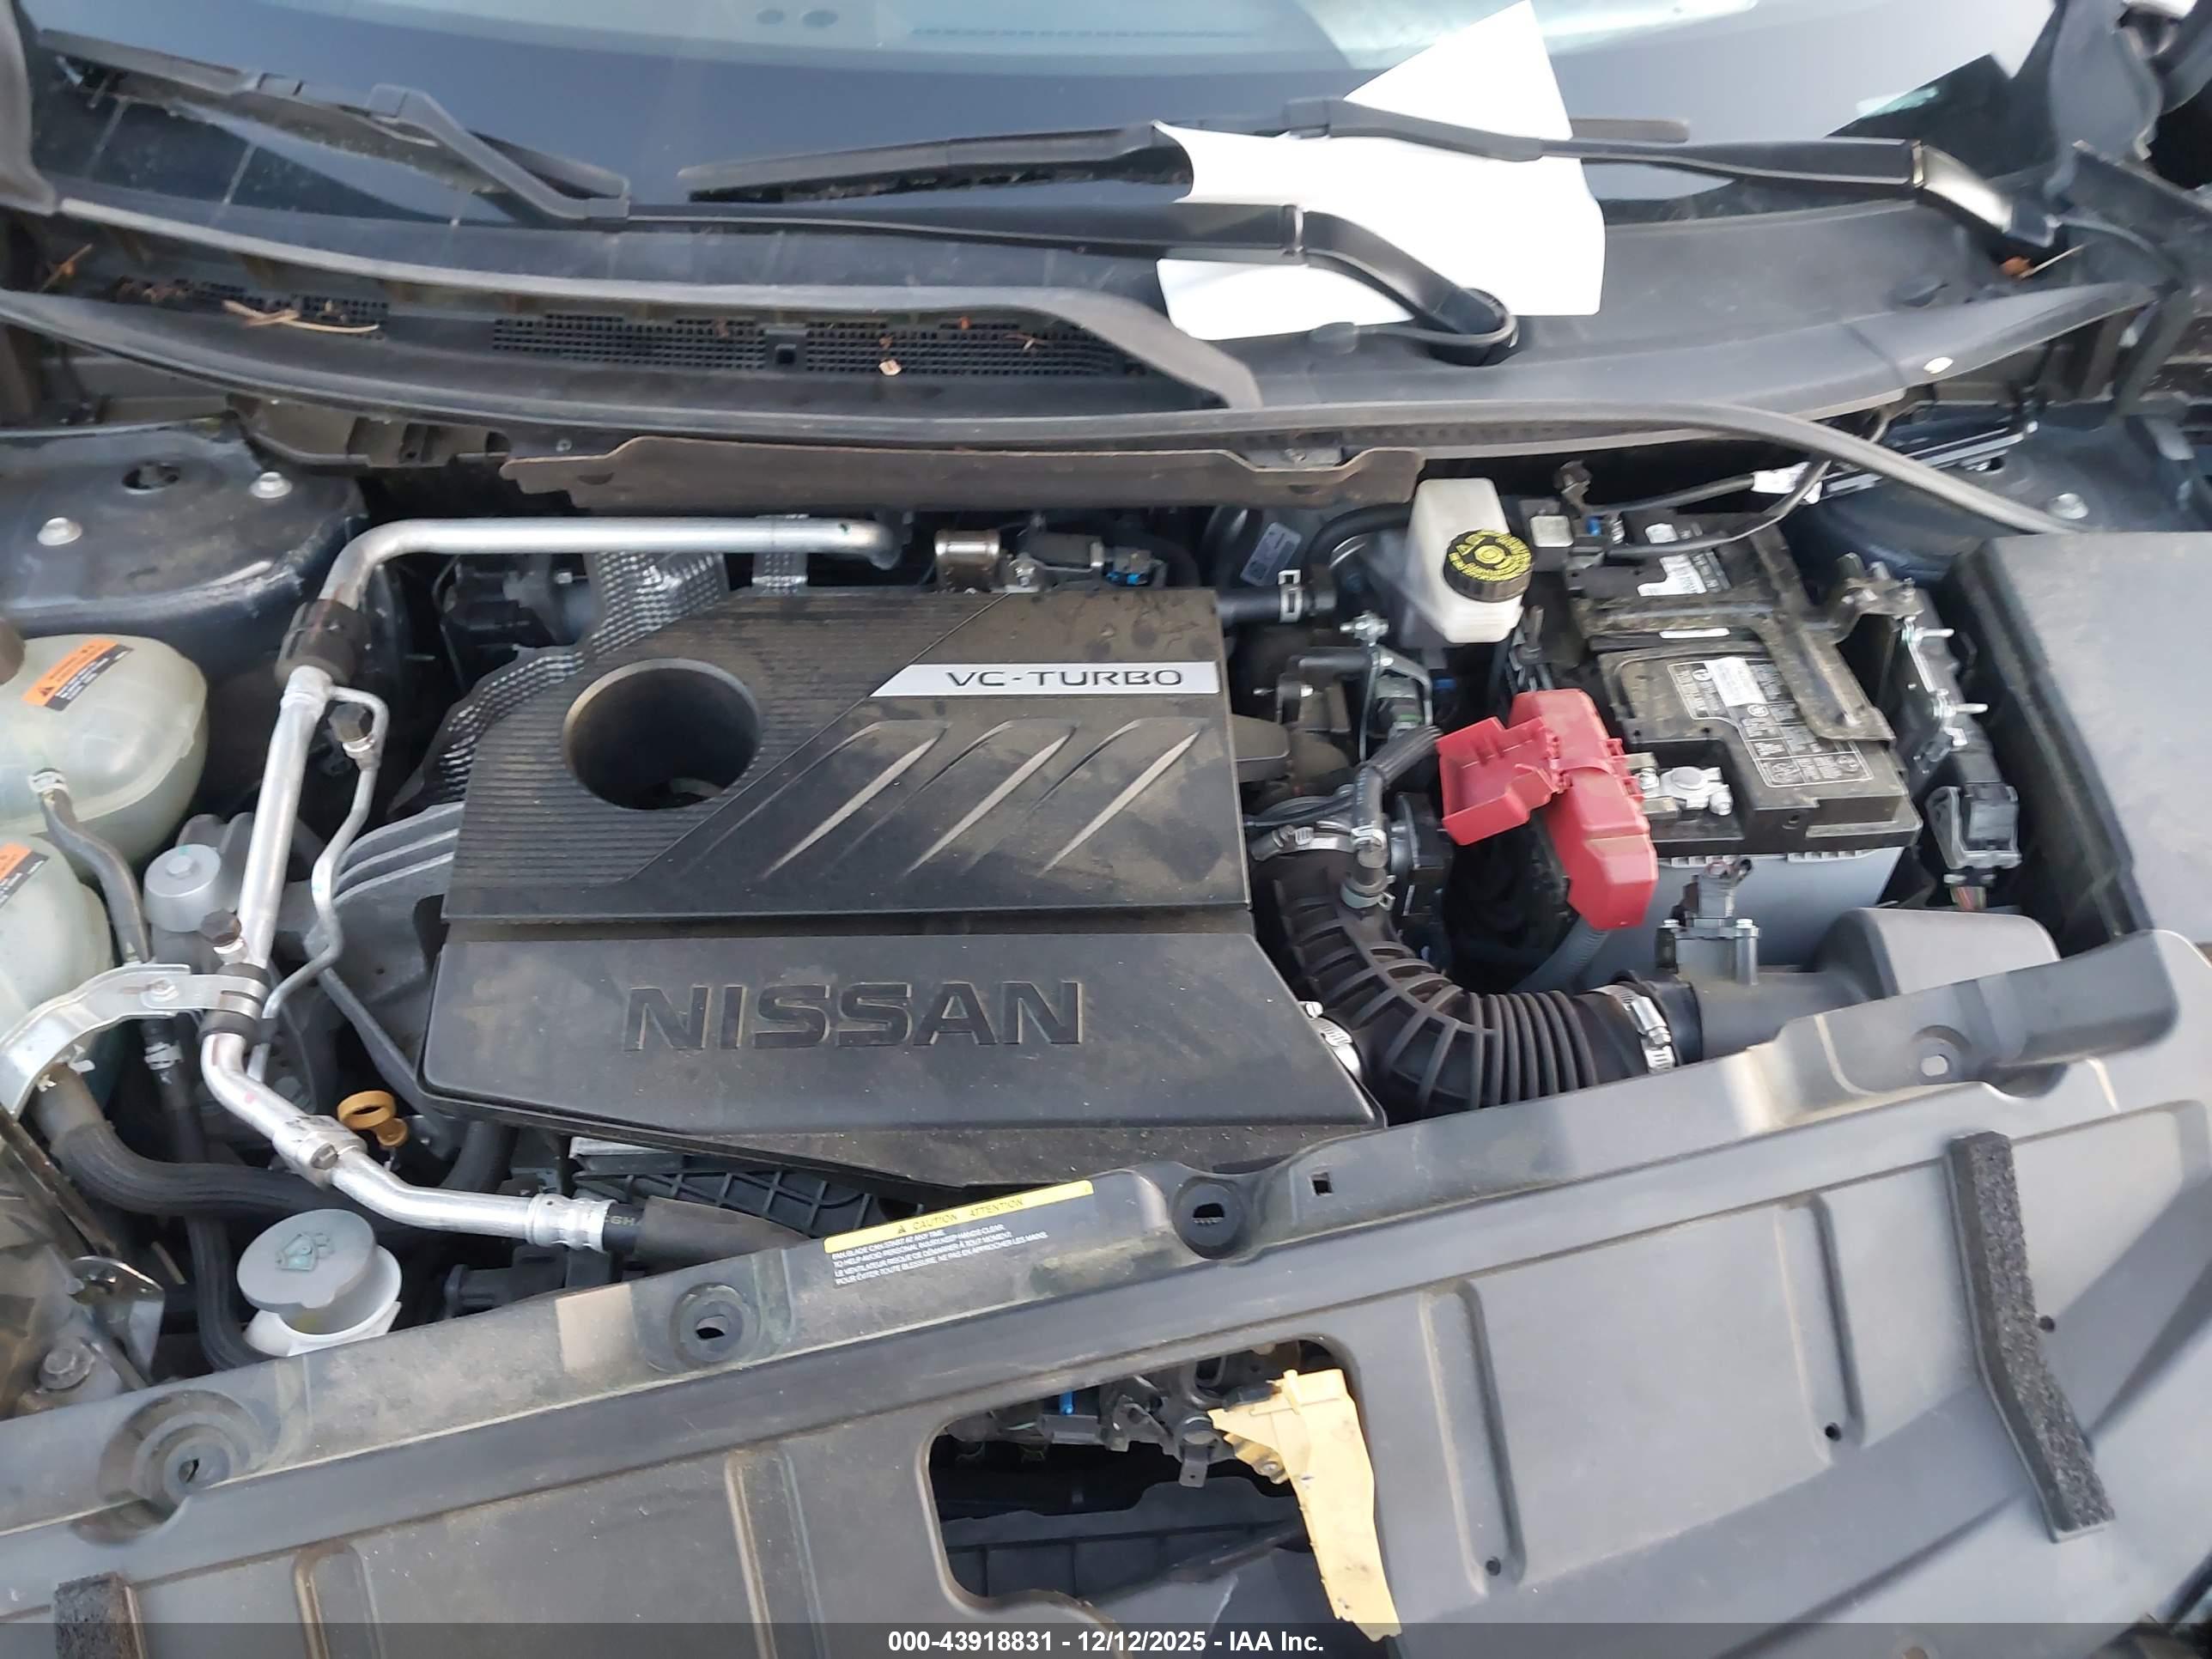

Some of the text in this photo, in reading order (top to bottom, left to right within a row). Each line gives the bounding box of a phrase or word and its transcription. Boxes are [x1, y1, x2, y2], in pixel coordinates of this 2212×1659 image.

[946, 669, 1183, 687] VC-TURBO
[623, 981, 1083, 1051] NISSAN
[913, 1197, 1024, 1230] CAUTION ATTENTION
